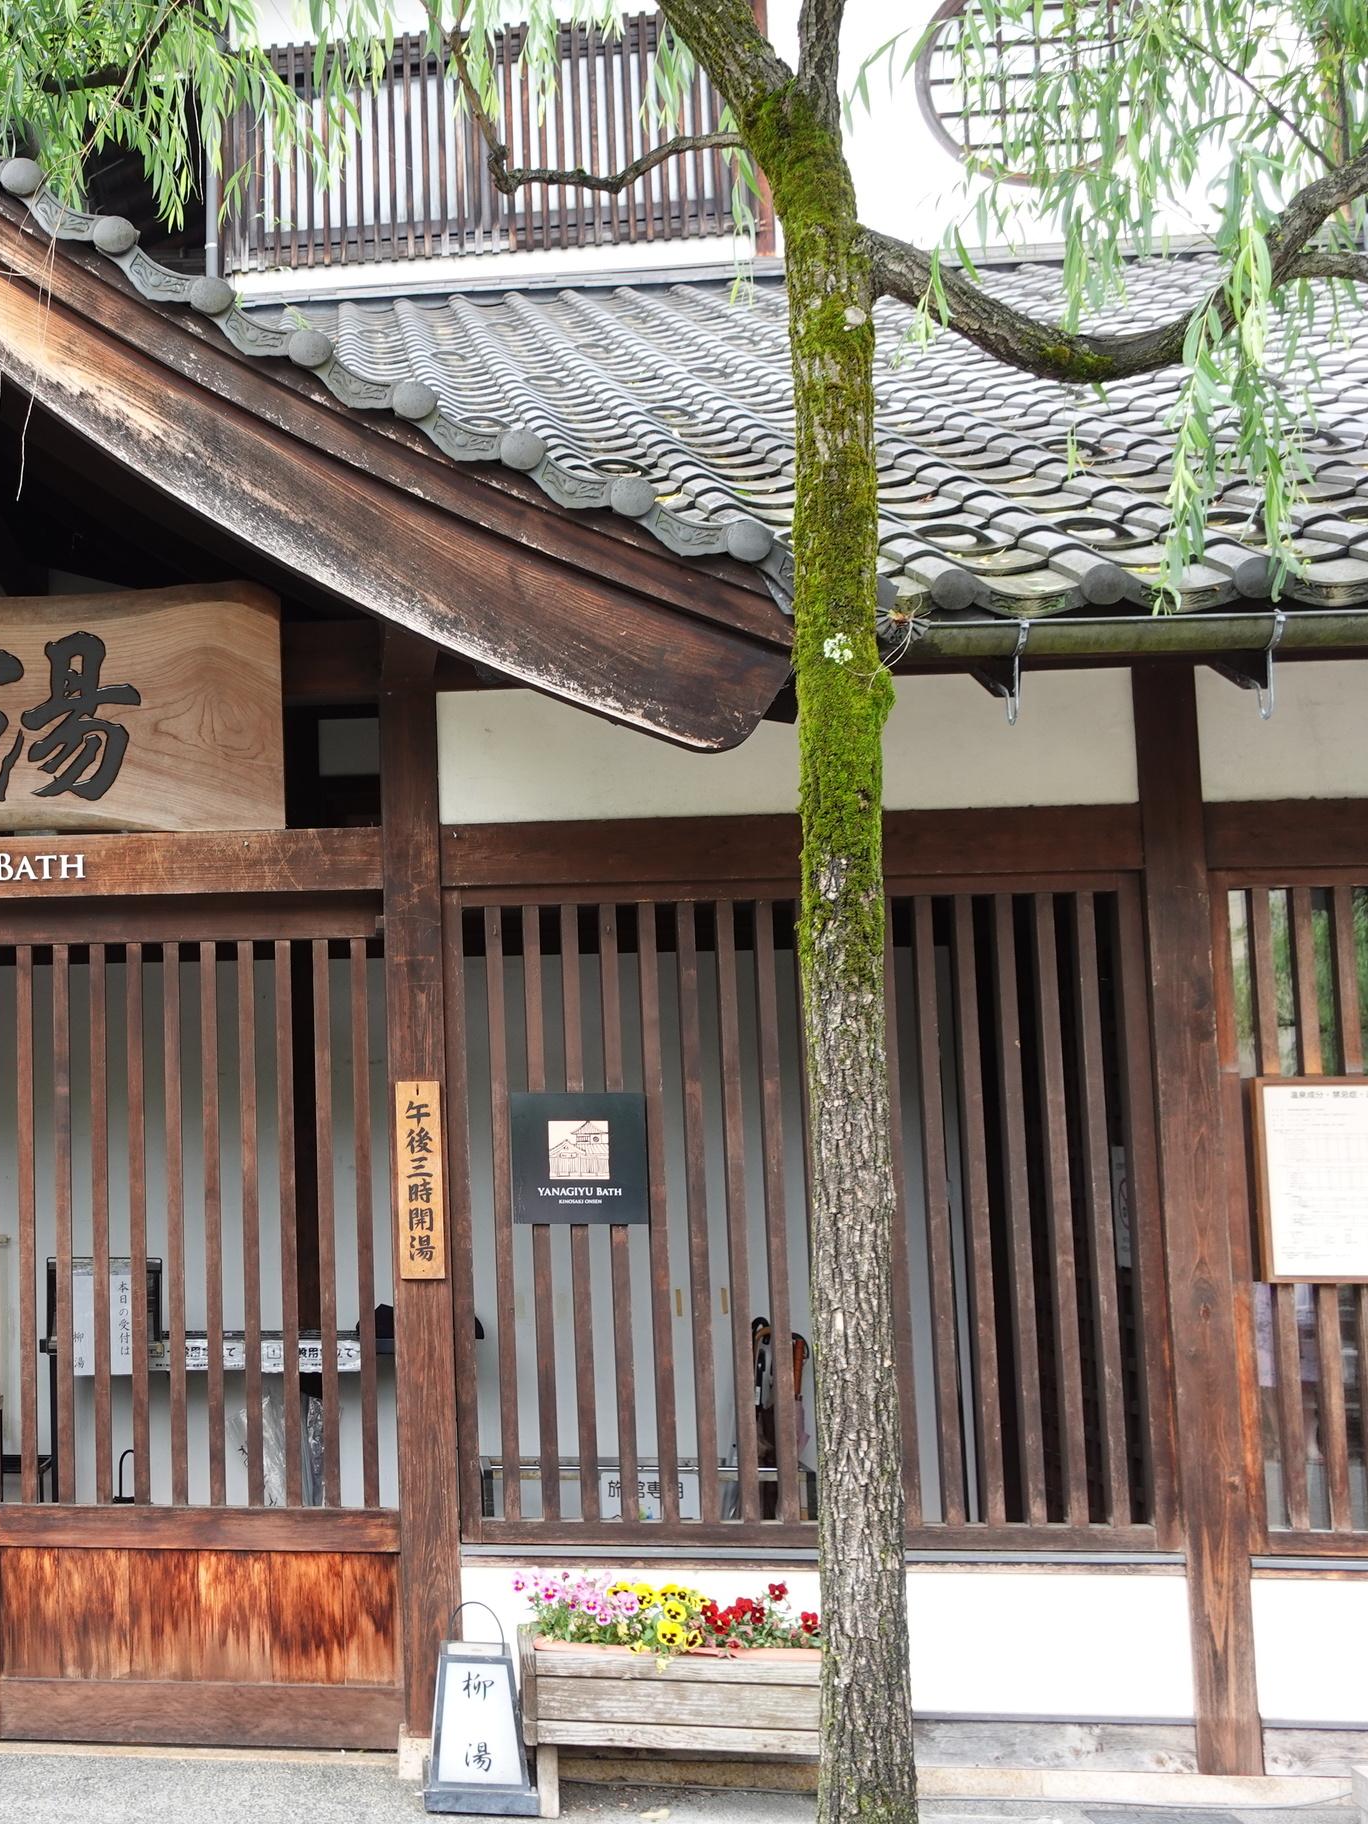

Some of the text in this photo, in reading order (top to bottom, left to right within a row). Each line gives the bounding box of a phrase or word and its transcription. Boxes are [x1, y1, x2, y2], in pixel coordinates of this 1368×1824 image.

[405, 1100, 436, 1262] 午後三時開湯
[537, 1187, 593, 1197] YANAGIYU
[118, 1281, 131, 1356] 本日の受付は
[462, 1671, 495, 1774] 柳湯
